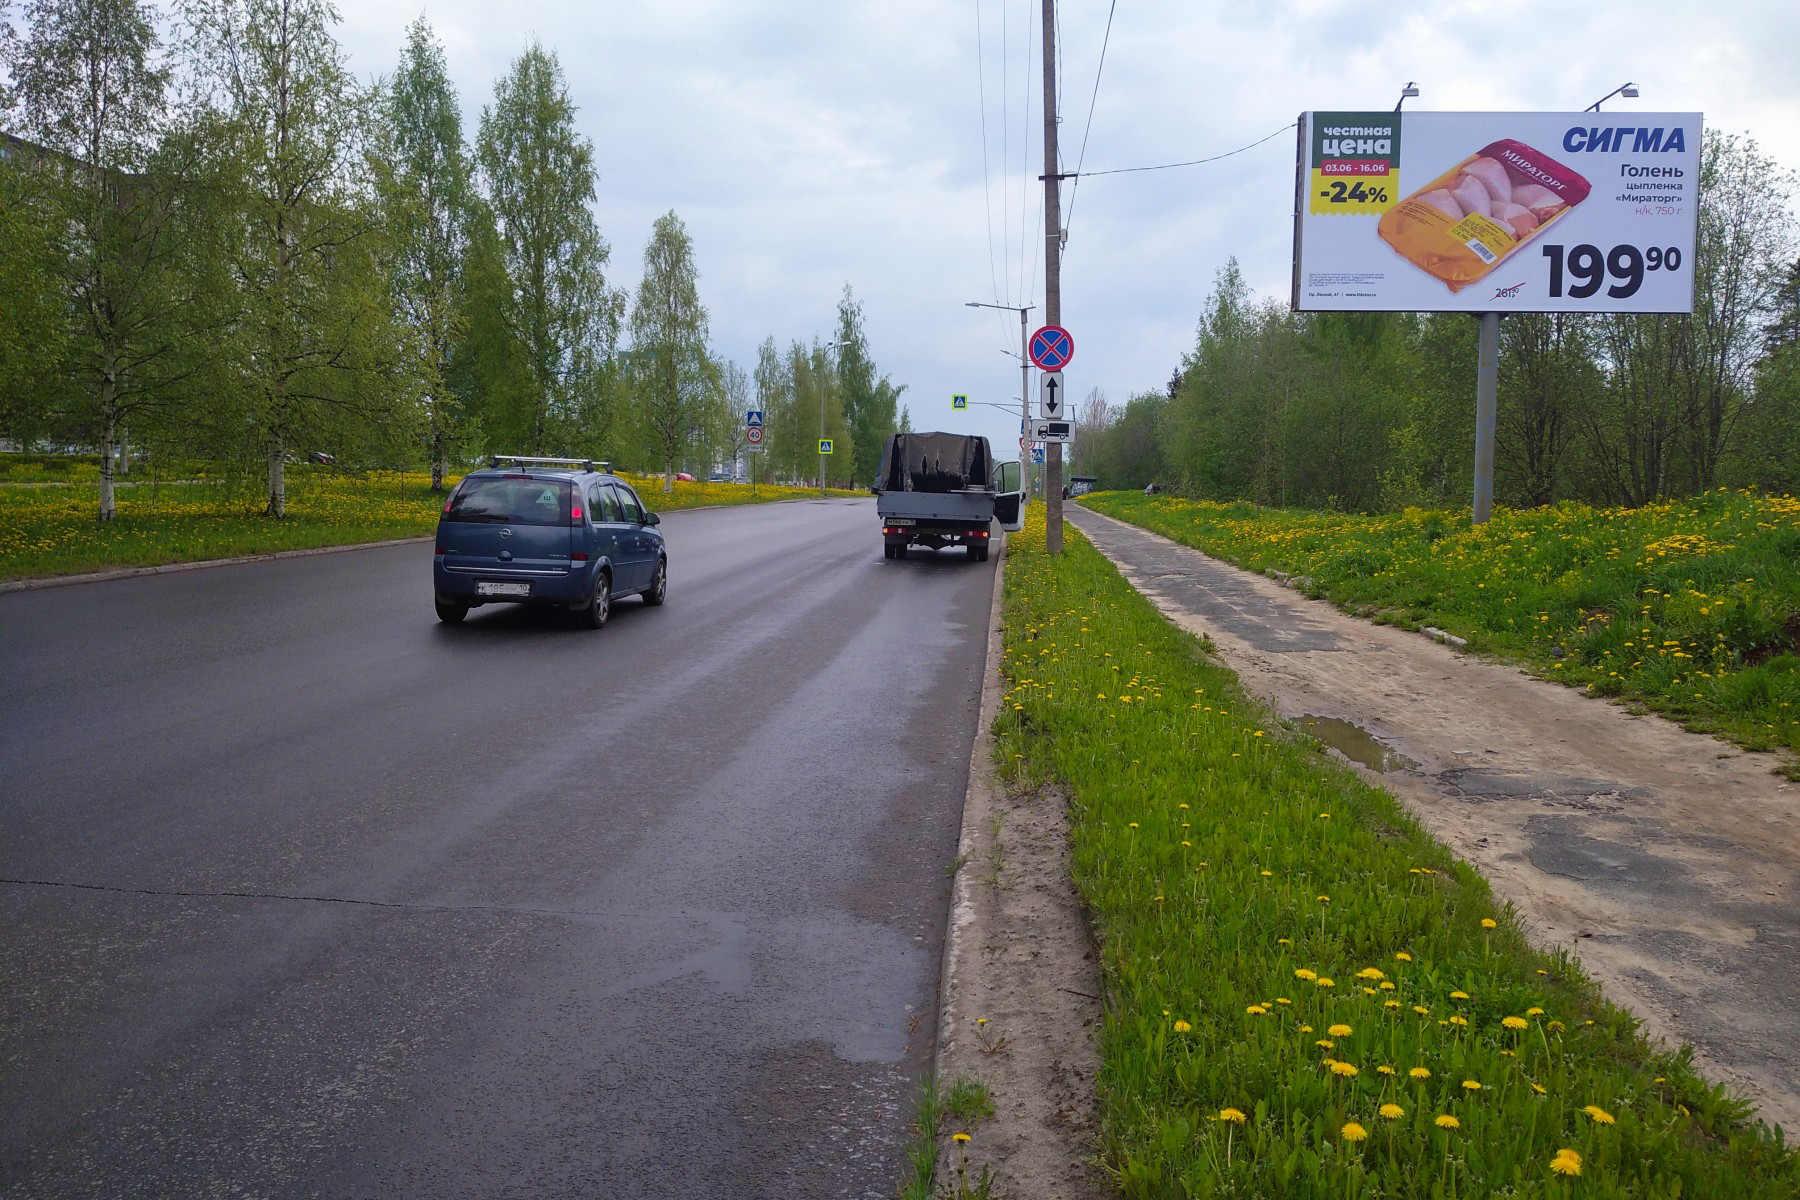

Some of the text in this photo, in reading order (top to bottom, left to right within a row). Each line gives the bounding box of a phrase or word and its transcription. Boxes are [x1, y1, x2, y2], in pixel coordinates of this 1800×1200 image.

[1323, 126, 1392, 136] честная
[1563, 126, 1686, 153] СИГМА
[1322, 138, 1392, 157] цена
[1325, 164, 1352, 172] 03.06
[1360, 164, 1385, 172] 16.06
[1501, 149, 1568, 190] МИРАТОРГ
[1620, 163, 1684, 178] Голень
[1320, 181, 1388, 203] -24%
[1626, 182, 1683, 191] цыпленка
[1615, 193, 1683, 204] «Мираторг»
[1635, 205, 1653, 216] н/к,
[1655, 206, 1675, 215] 750
[750, 431, 760, 439] 40
